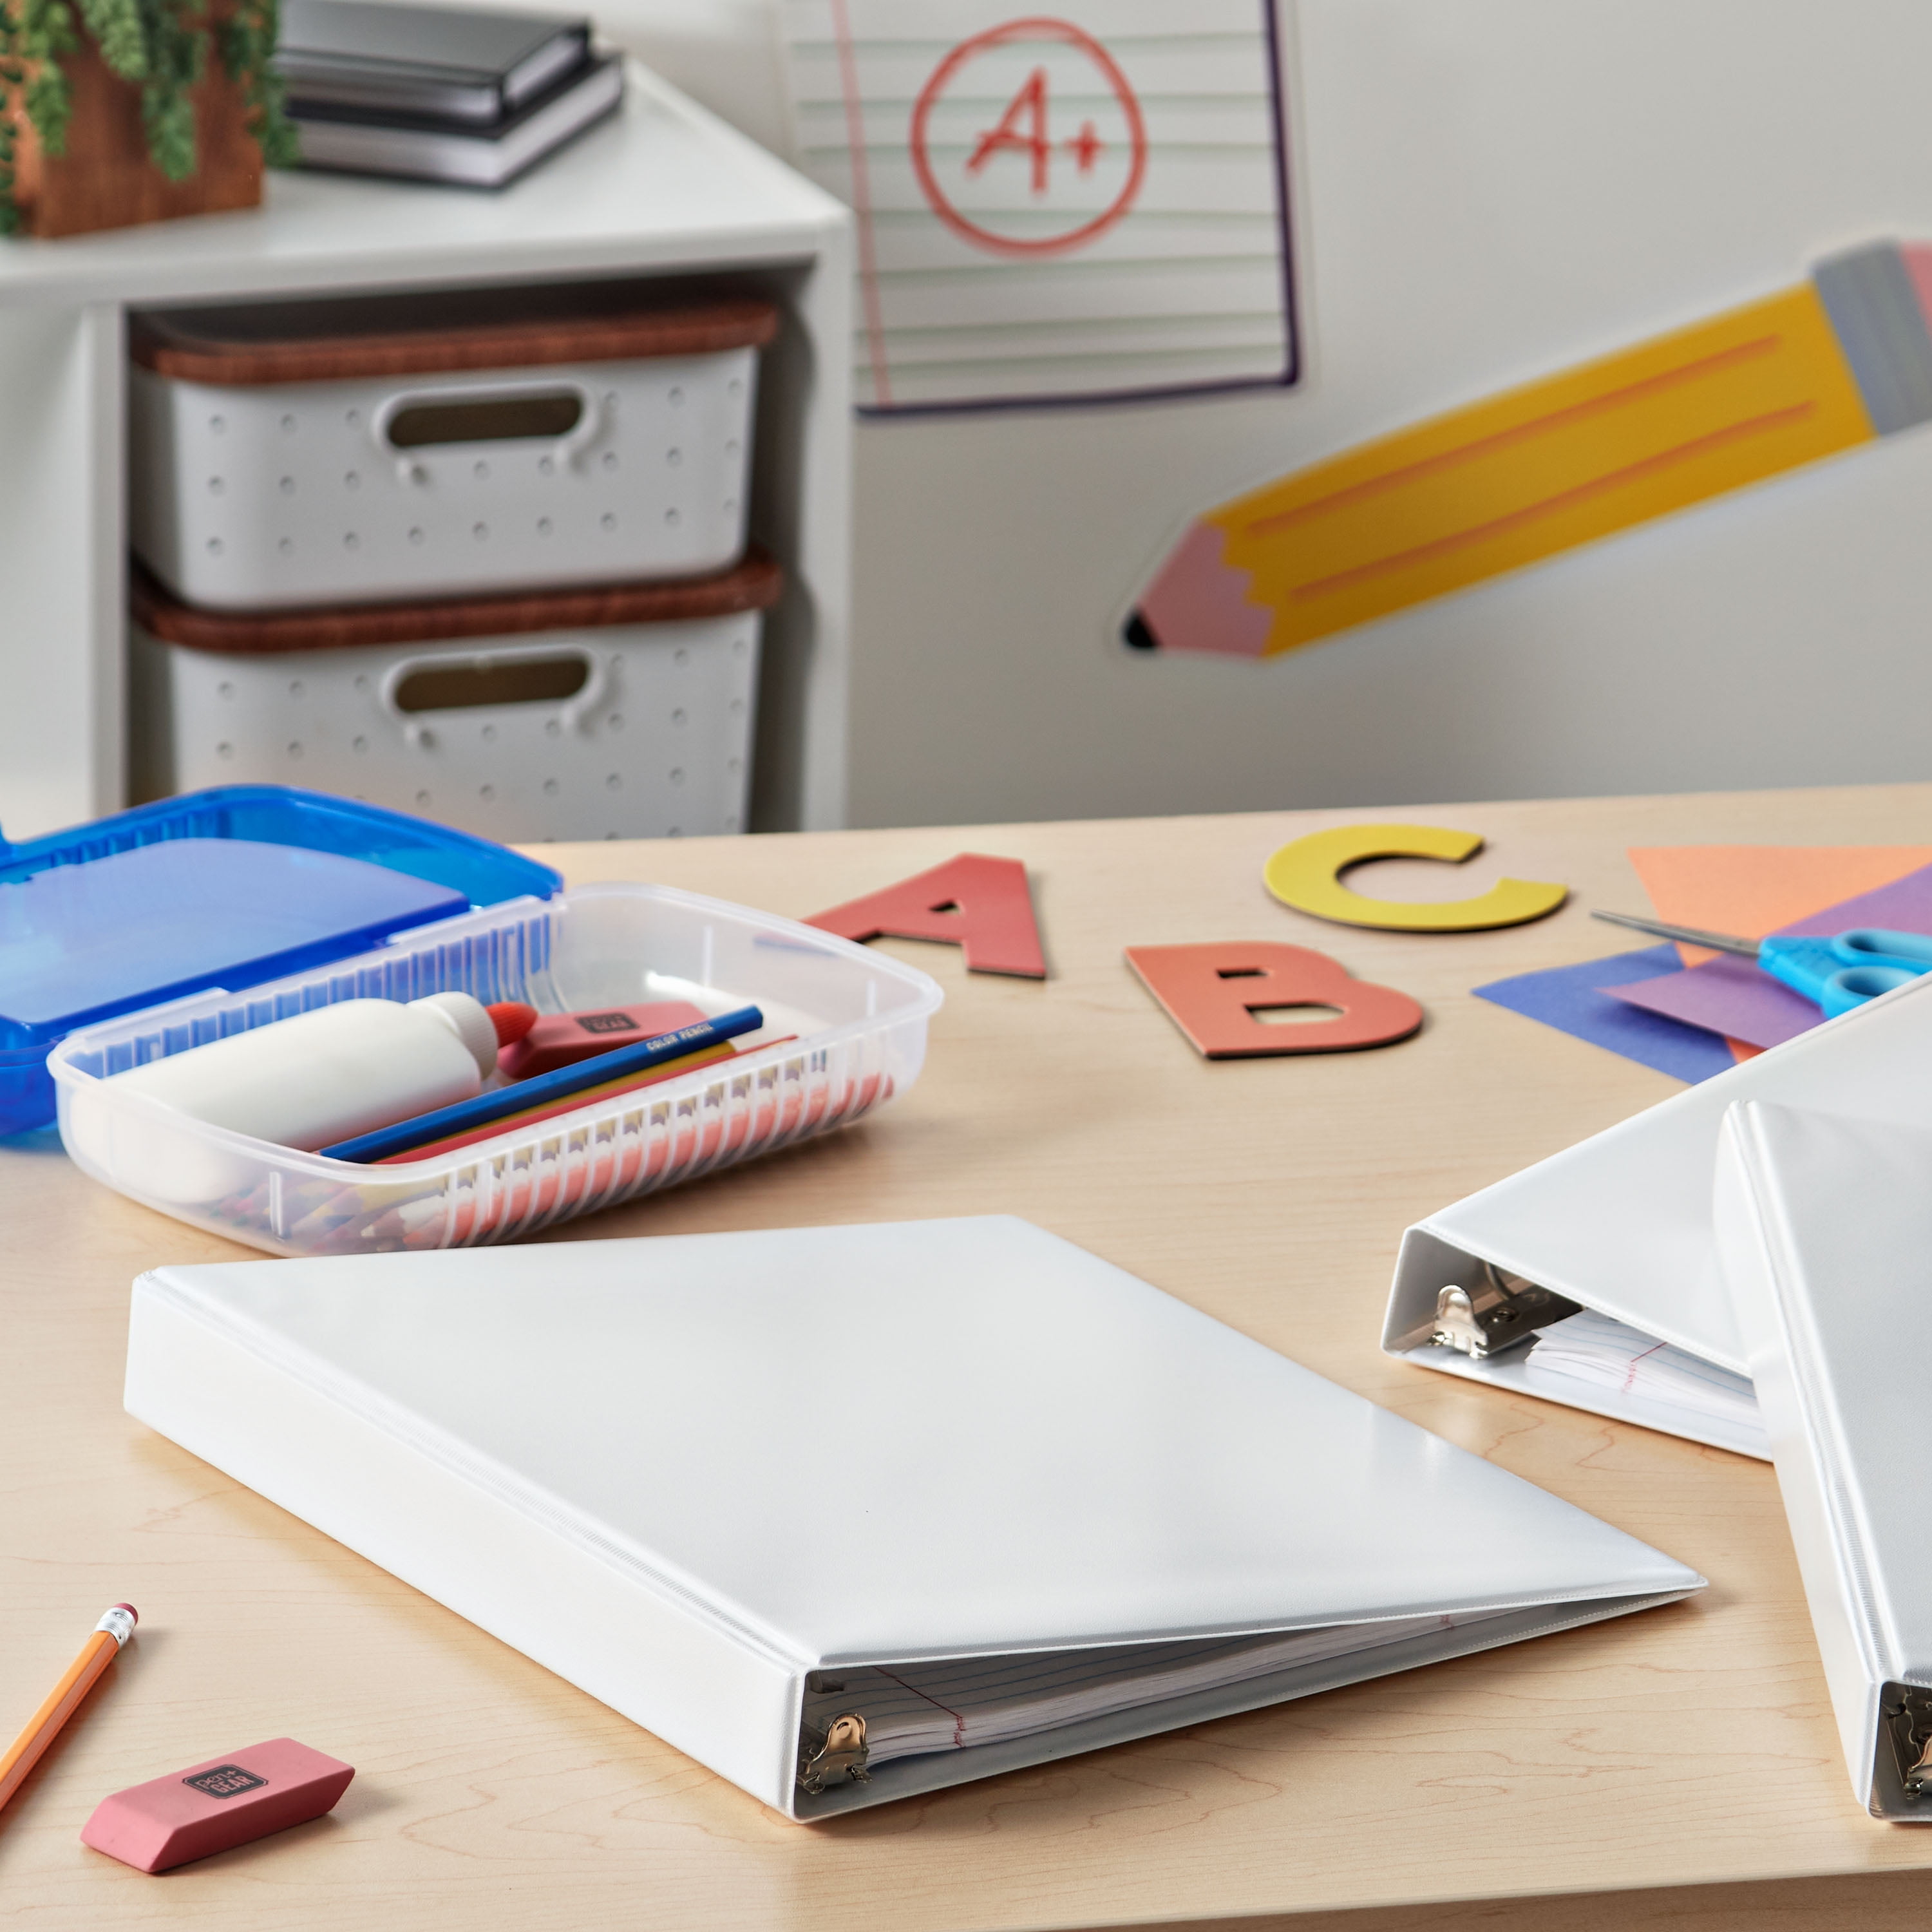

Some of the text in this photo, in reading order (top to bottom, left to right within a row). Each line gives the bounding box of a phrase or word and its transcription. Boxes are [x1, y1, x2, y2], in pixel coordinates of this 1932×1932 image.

[966, 66, 1105, 197] A+
[799, 852, 1046, 980] A
[1264, 824, 1569, 932] C
[646, 1023, 713, 1052] COLOR PENCIL
[1126, 940, 1425, 1059] B
[211, 1776, 254, 1793] GEAR
